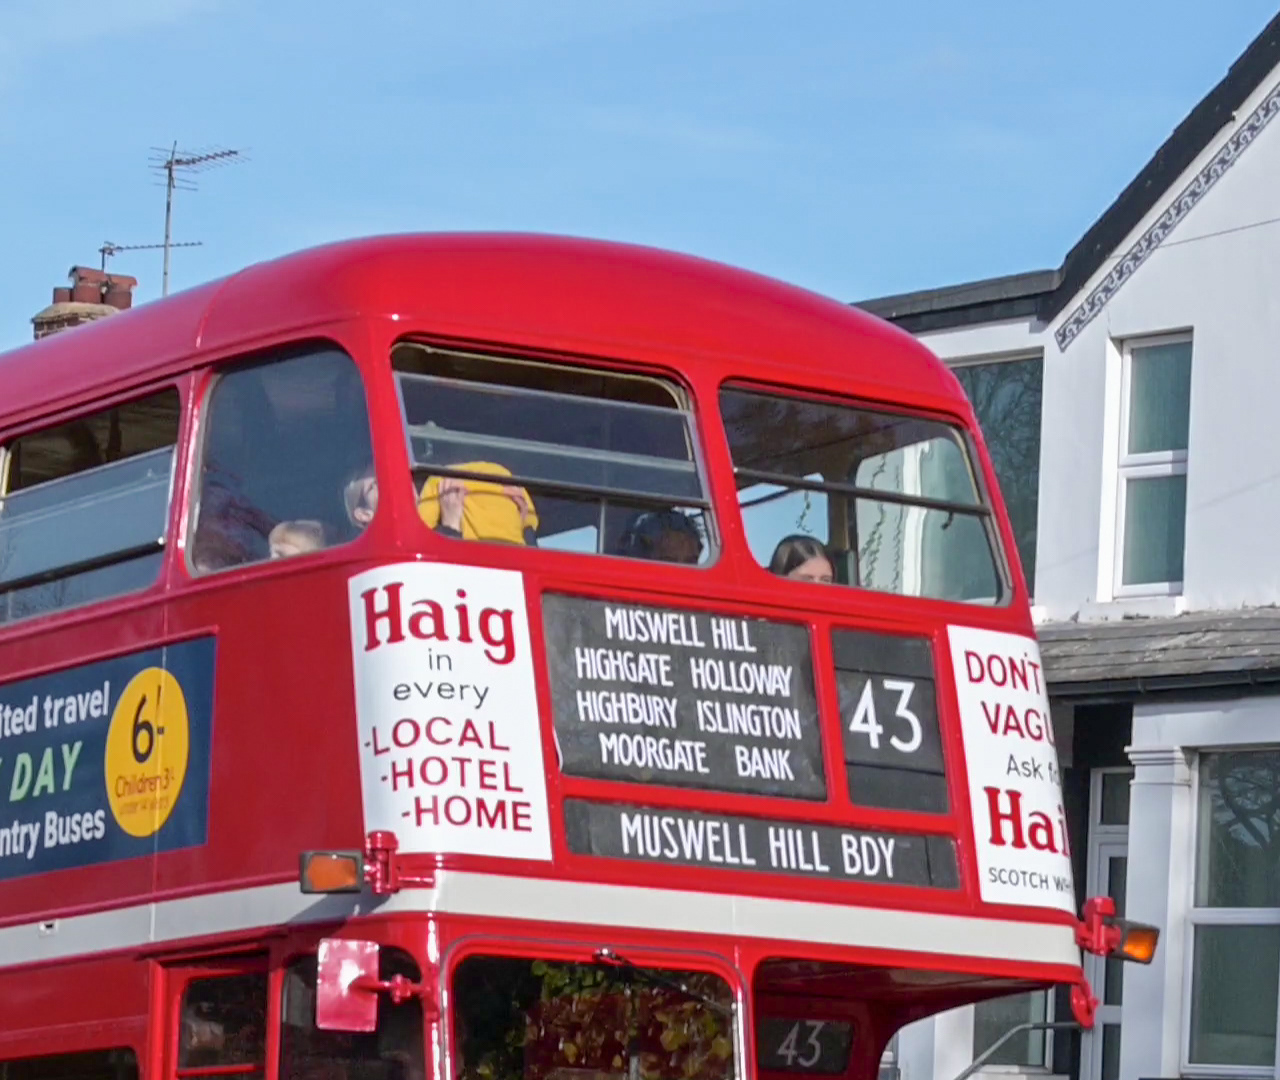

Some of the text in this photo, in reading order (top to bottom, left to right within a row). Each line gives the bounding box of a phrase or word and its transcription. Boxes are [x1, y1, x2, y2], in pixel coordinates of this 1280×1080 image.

[361, 582, 516, 665] Haig
[604, 608, 757, 652] MUSWELL HILL
[428, 648, 452, 671] in
[575, 647, 792, 697] HIGHGATE HOLLOWAY
[43, 680, 110, 728] travel
[393, 681, 489, 709] every
[576, 690, 801, 740] HIGHBURY ISLINGTON
[849, 678, 923, 753] 43
[9, 741, 83, 802] DAY
[599, 733, 795, 782] MOORGATE BANK
[1006, 753, 1044, 781] Ask
[44, 809, 106, 848] Buses
[620, 813, 896, 878] MUSWELL HILL BDY
[989, 867, 1049, 891] SCOTCH
[776, 1020, 825, 1067] 43
